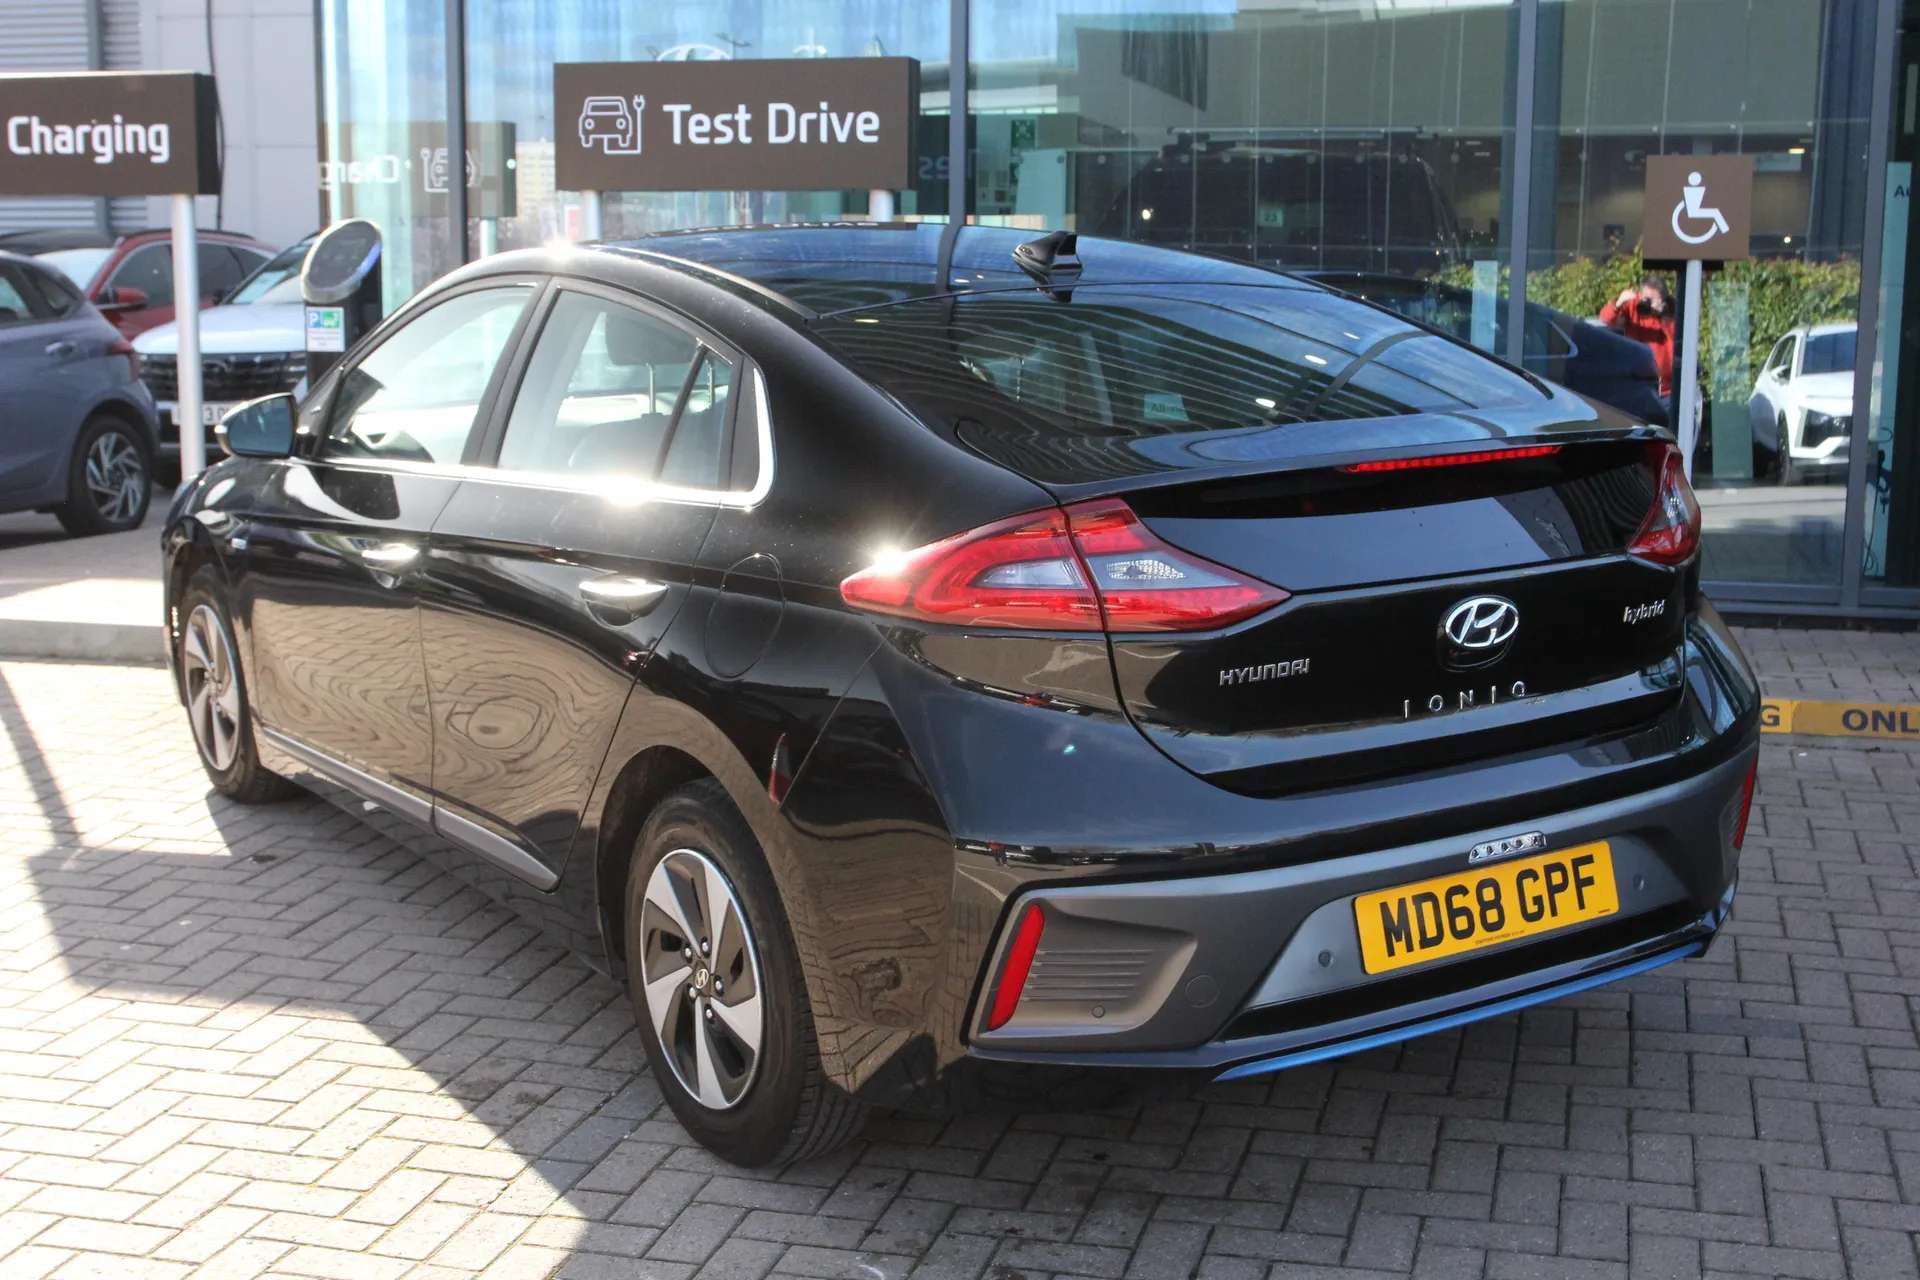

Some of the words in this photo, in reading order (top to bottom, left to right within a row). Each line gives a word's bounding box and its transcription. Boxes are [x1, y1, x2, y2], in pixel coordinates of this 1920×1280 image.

[7, 114, 169, 164] Charging
[662, 103, 752, 145] Test
[767, 101, 880, 144] Drive
[1623, 599, 1665, 625] hybrid
[1219, 658, 1310, 686] HYUNDAI
[1404, 680, 1526, 719] IONIQ
[1379, 877, 1506, 958] MD68
[1516, 854, 1595, 923] GPF
